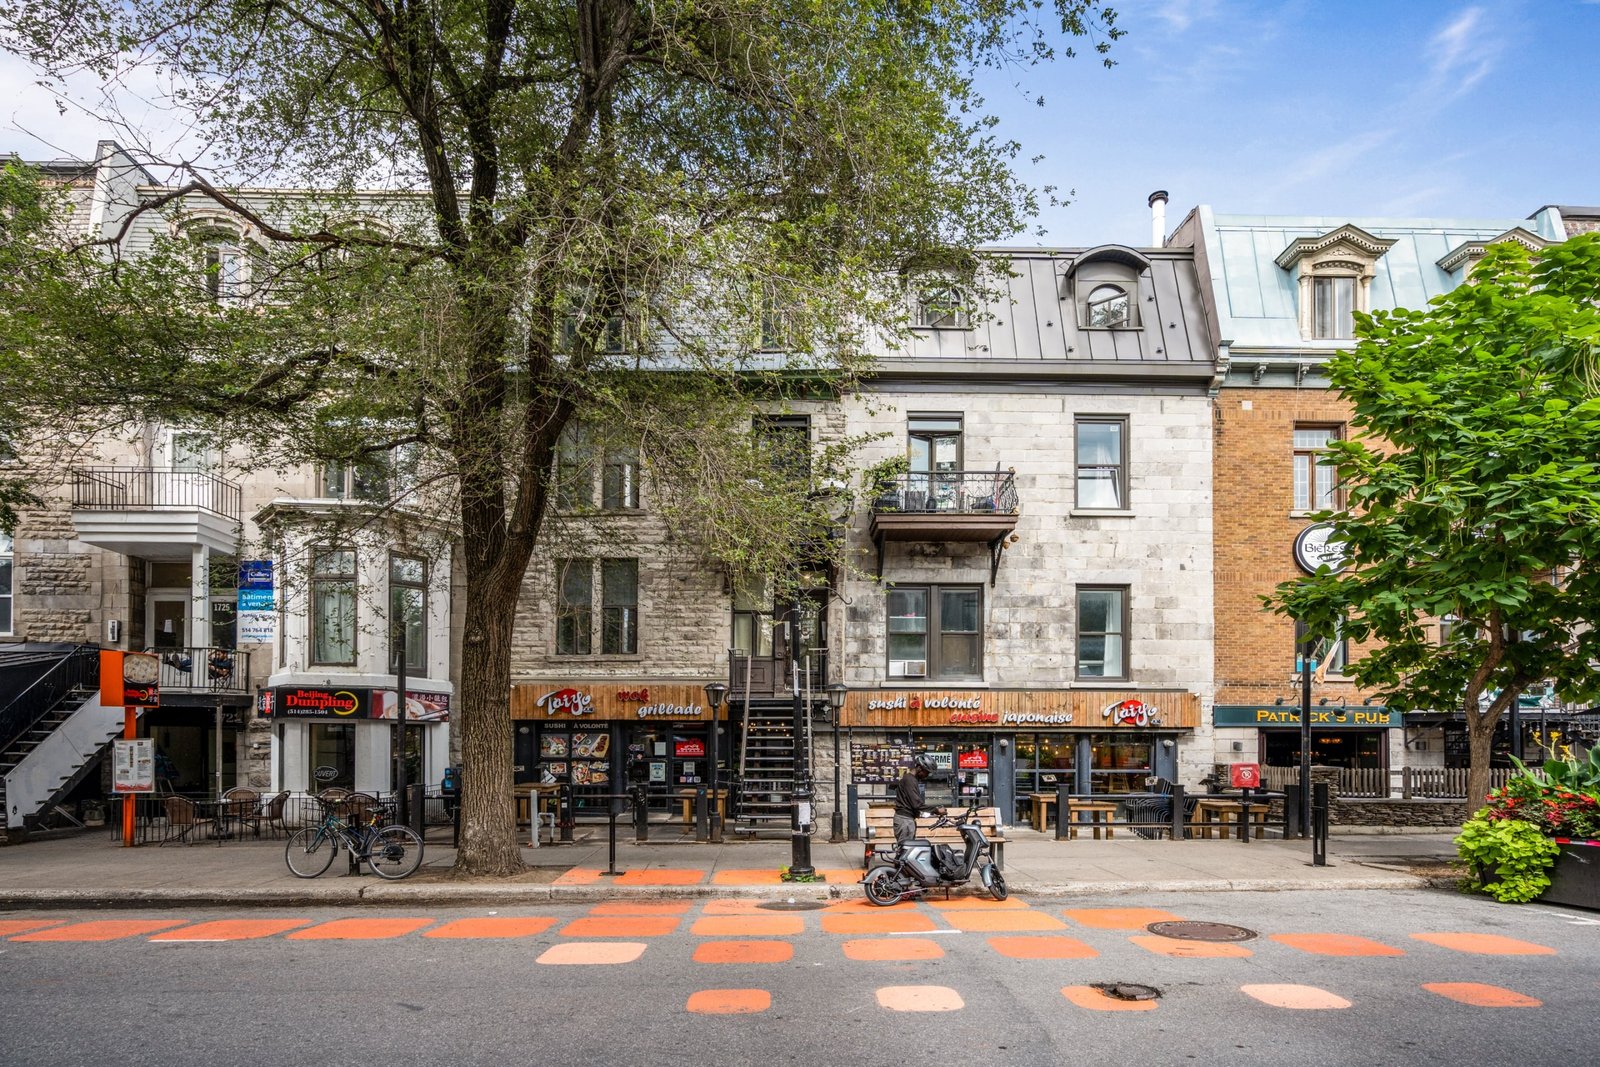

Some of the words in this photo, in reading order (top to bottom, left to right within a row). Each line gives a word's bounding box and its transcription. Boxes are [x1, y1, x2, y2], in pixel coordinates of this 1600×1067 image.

[213, 603, 231, 612] 1725
[297, 689, 329, 699] Beijing
[617, 688, 650, 704] wok
[286, 694, 354, 710] Dumpling
[536, 690, 592, 716] Taiyo
[868, 696, 908, 710] sushi
[910, 696, 920, 709] à
[924, 696, 981, 709] volonté
[637, 703, 703, 718] grillade
[949, 710, 999, 723] cuisine
[1002, 710, 1073, 724] japonaise
[1102, 700, 1158, 727] Taiyo
[1257, 710, 1347, 723] PATRCK'S
[1353, 712, 1390, 723] PUB
[314, 770, 337, 778] OUVERT
